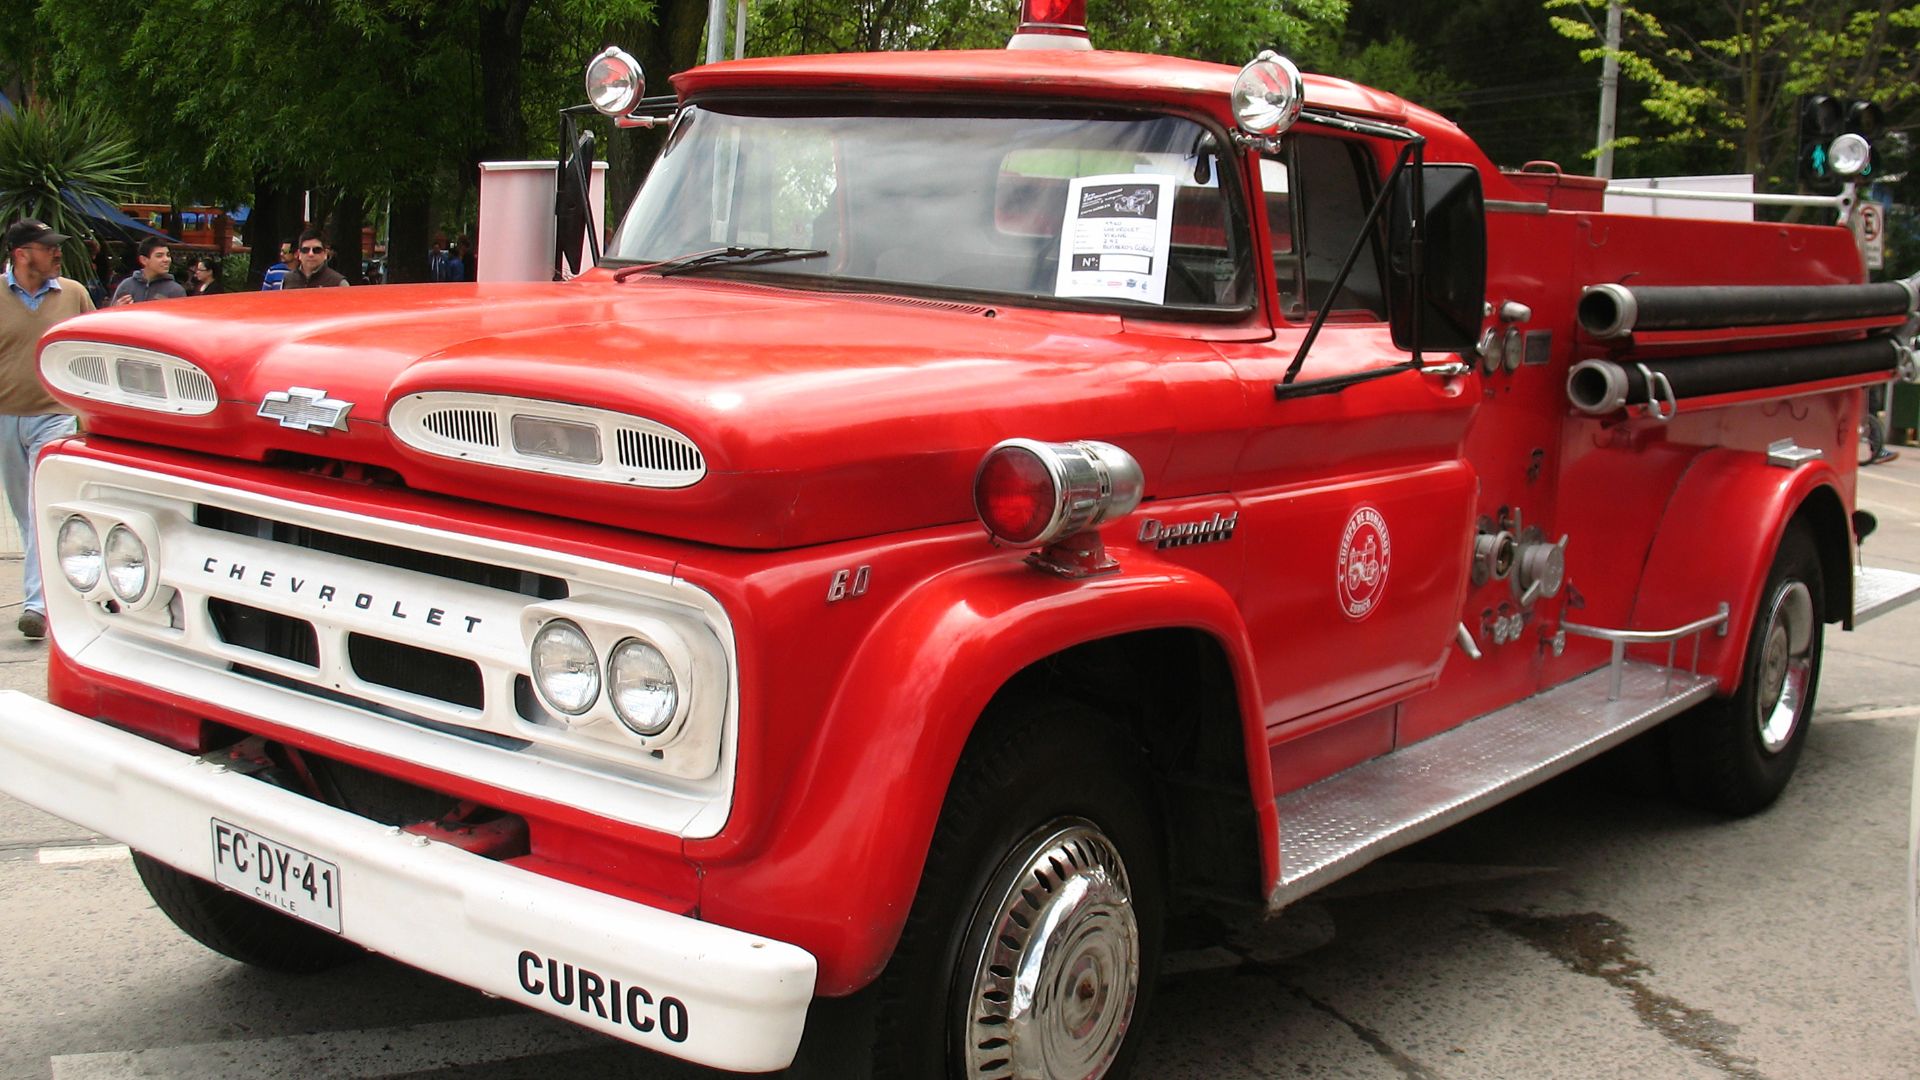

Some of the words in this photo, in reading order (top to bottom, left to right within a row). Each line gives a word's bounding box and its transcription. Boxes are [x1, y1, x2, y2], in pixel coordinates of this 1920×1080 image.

[1139, 511, 1238, 543] Chevrolet
[1340, 520, 1357, 565] CUERPO
[1356, 511, 1365, 522] DE
[1365, 511, 1389, 556] BOMBEROS
[203, 557, 482, 633] CHEVROLET
[828, 565, 871, 601] 60
[1349, 598, 1372, 614] CURICO
[255, 886, 296, 912] CHILE
[518, 950, 689, 1043] CURICO
